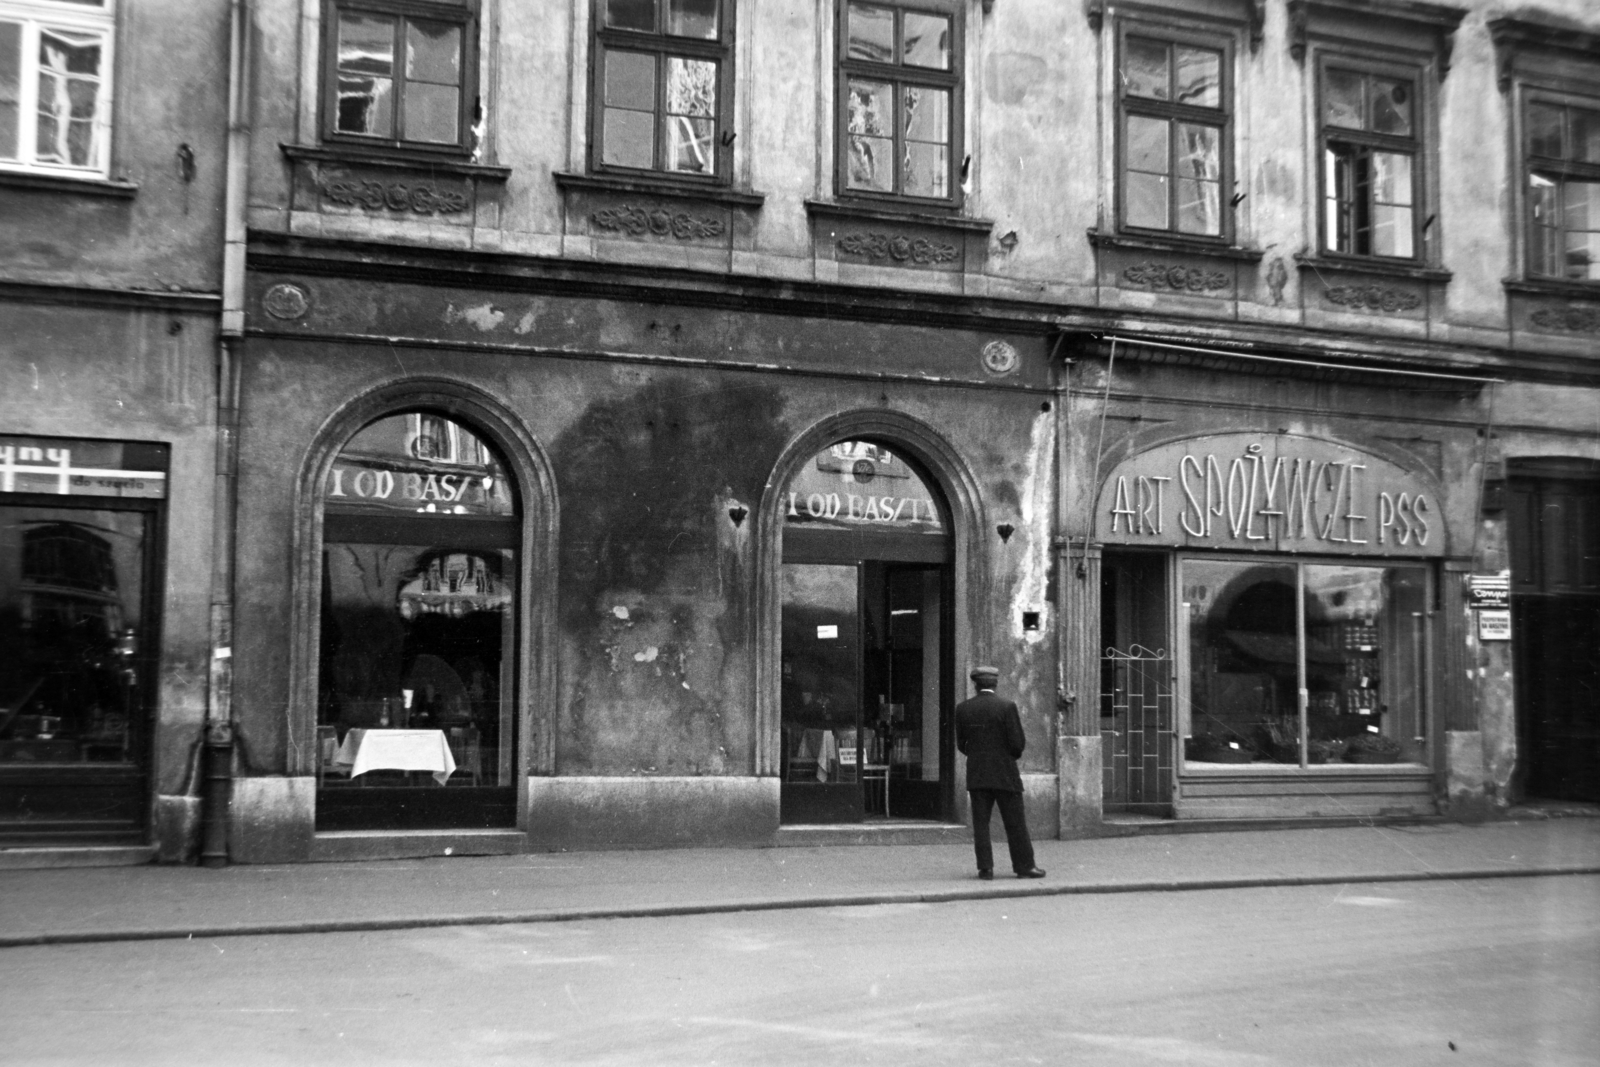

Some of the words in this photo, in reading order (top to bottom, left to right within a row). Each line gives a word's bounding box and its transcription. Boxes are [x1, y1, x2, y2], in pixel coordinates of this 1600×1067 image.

[1112, 476, 1172, 534] ART
[1180, 443, 1368, 544] SPOŻYWCZE
[1377, 491, 1428, 546] PSS
